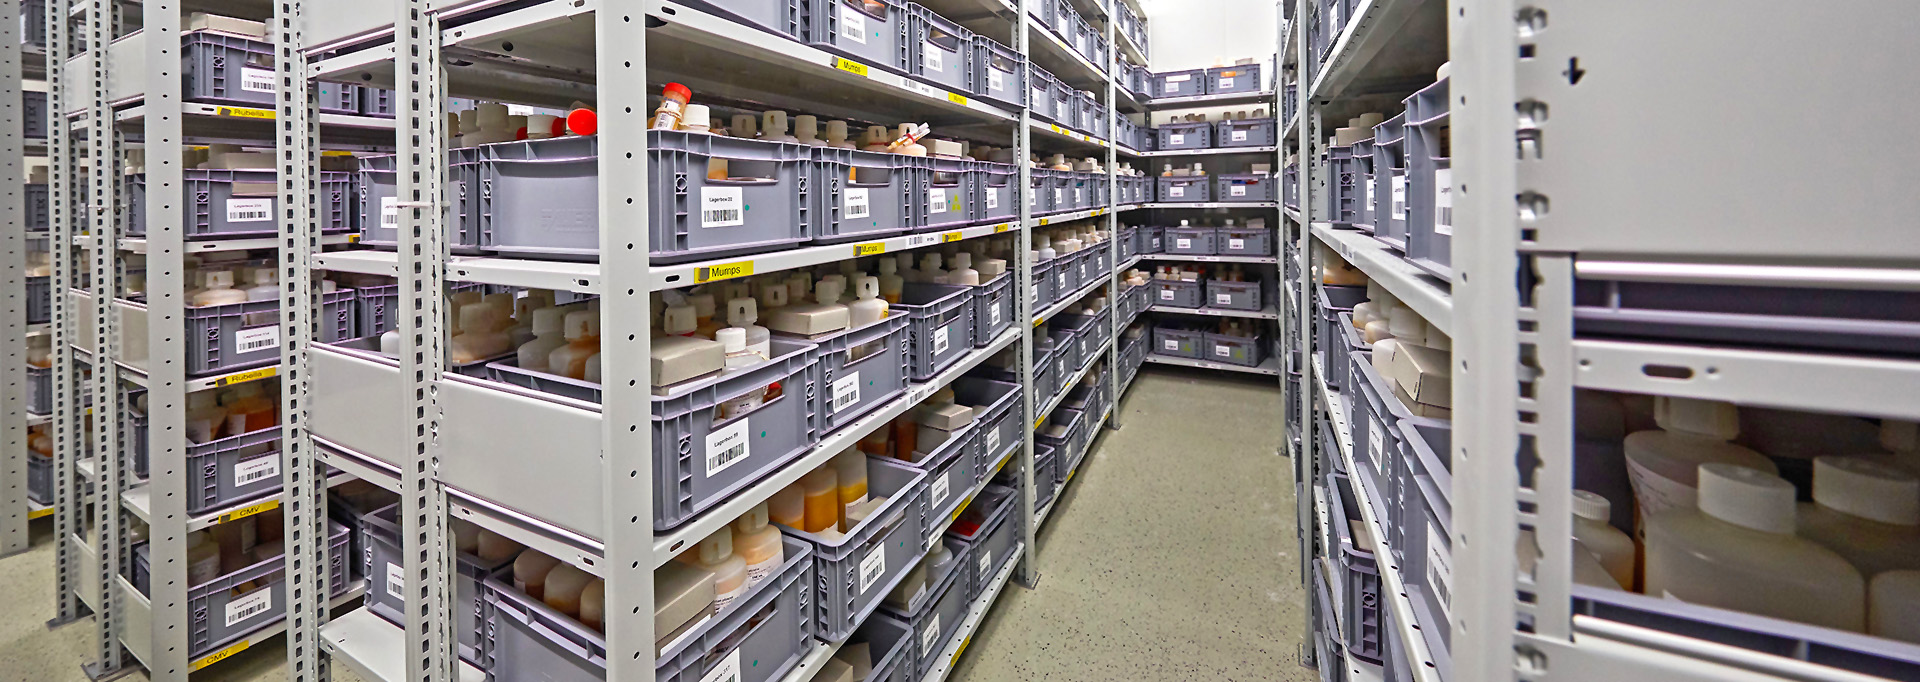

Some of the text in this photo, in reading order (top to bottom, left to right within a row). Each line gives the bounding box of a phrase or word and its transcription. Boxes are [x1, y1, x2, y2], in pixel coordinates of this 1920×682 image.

[843, 61, 861, 73] Mumps
[234, 108, 265, 117] Rubella
[861, 245, 878, 253] Mumps
[711, 266, 741, 278] Mumps
[231, 371, 262, 383] Rubella
[714, 435, 733, 448] Lagerbox
[239, 505, 261, 517] CMV
[206, 650, 229, 664] CMV
